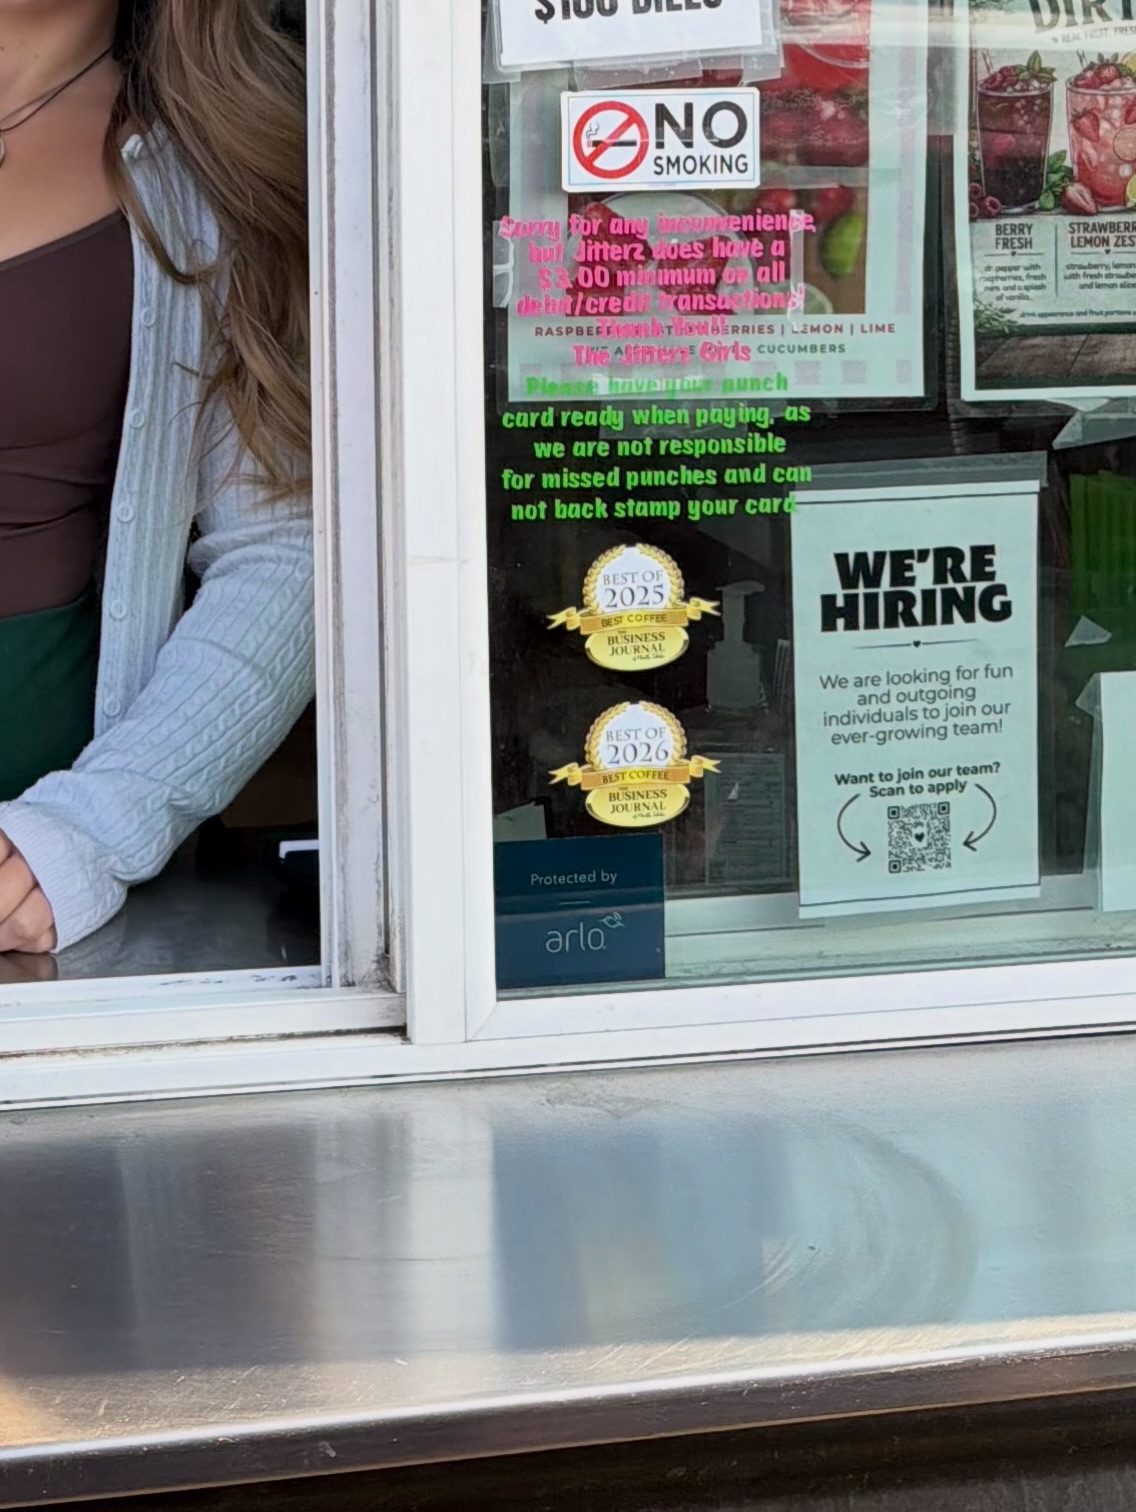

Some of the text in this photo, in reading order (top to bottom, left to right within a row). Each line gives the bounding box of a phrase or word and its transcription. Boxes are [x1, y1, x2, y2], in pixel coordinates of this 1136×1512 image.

[655, 100, 748, 150] NO
[654, 154, 748, 176] SMOKING
[569, 215, 603, 237] for
[609, 215, 649, 239] any
[657, 210, 816, 234] inconvenience,
[995, 223, 1033, 236] BERRY
[529, 237, 785, 263] but Jitterz does have a
[995, 235, 1109, 250] FRESH LEMON
[616, 262, 785, 287] minimum on all
[862, 322, 896, 333] LIME
[573, 344, 611, 366] The
[699, 341, 752, 363] Girls
[757, 343, 846, 354] CUCUMBERS
[722, 372, 789, 395] punch
[502, 407, 554, 428] card
[561, 406, 624, 430] ready
[632, 405, 689, 426] when
[785, 405, 811, 422] as
[533, 433, 787, 458] we are not responsible
[501, 464, 812, 491] for missed punches and can
[511, 495, 796, 521] not back stamp your card
[602, 570, 664, 585] BEST OF
[833, 543, 997, 591] WE'RE
[605, 584, 665, 609] 2025
[820, 584, 1013, 632] HIRING
[601, 613, 668, 628] BEST COFFEE
[608, 632, 666, 646] BUSINESS
[609, 644, 665, 657] JOURNAL
[819, 664, 1014, 692] We are looking for fun
[857, 685, 976, 708] and outgoing
[823, 702, 1012, 728] individuals to join our
[606, 726, 667, 742] BEST OF
[830, 719, 1004, 747] ever-growing team!
[608, 740, 669, 766] 2026
[602, 770, 670, 785] BEST COFFEE
[835, 762, 1001, 786] Want to join our team?
[608, 789, 668, 802] BUSINESS
[869, 778, 968, 798] Scan to apply
[610, 801, 667, 814] JOURNAL
[531, 869, 618, 886] Protected by
[546, 920, 606, 953] arlo
